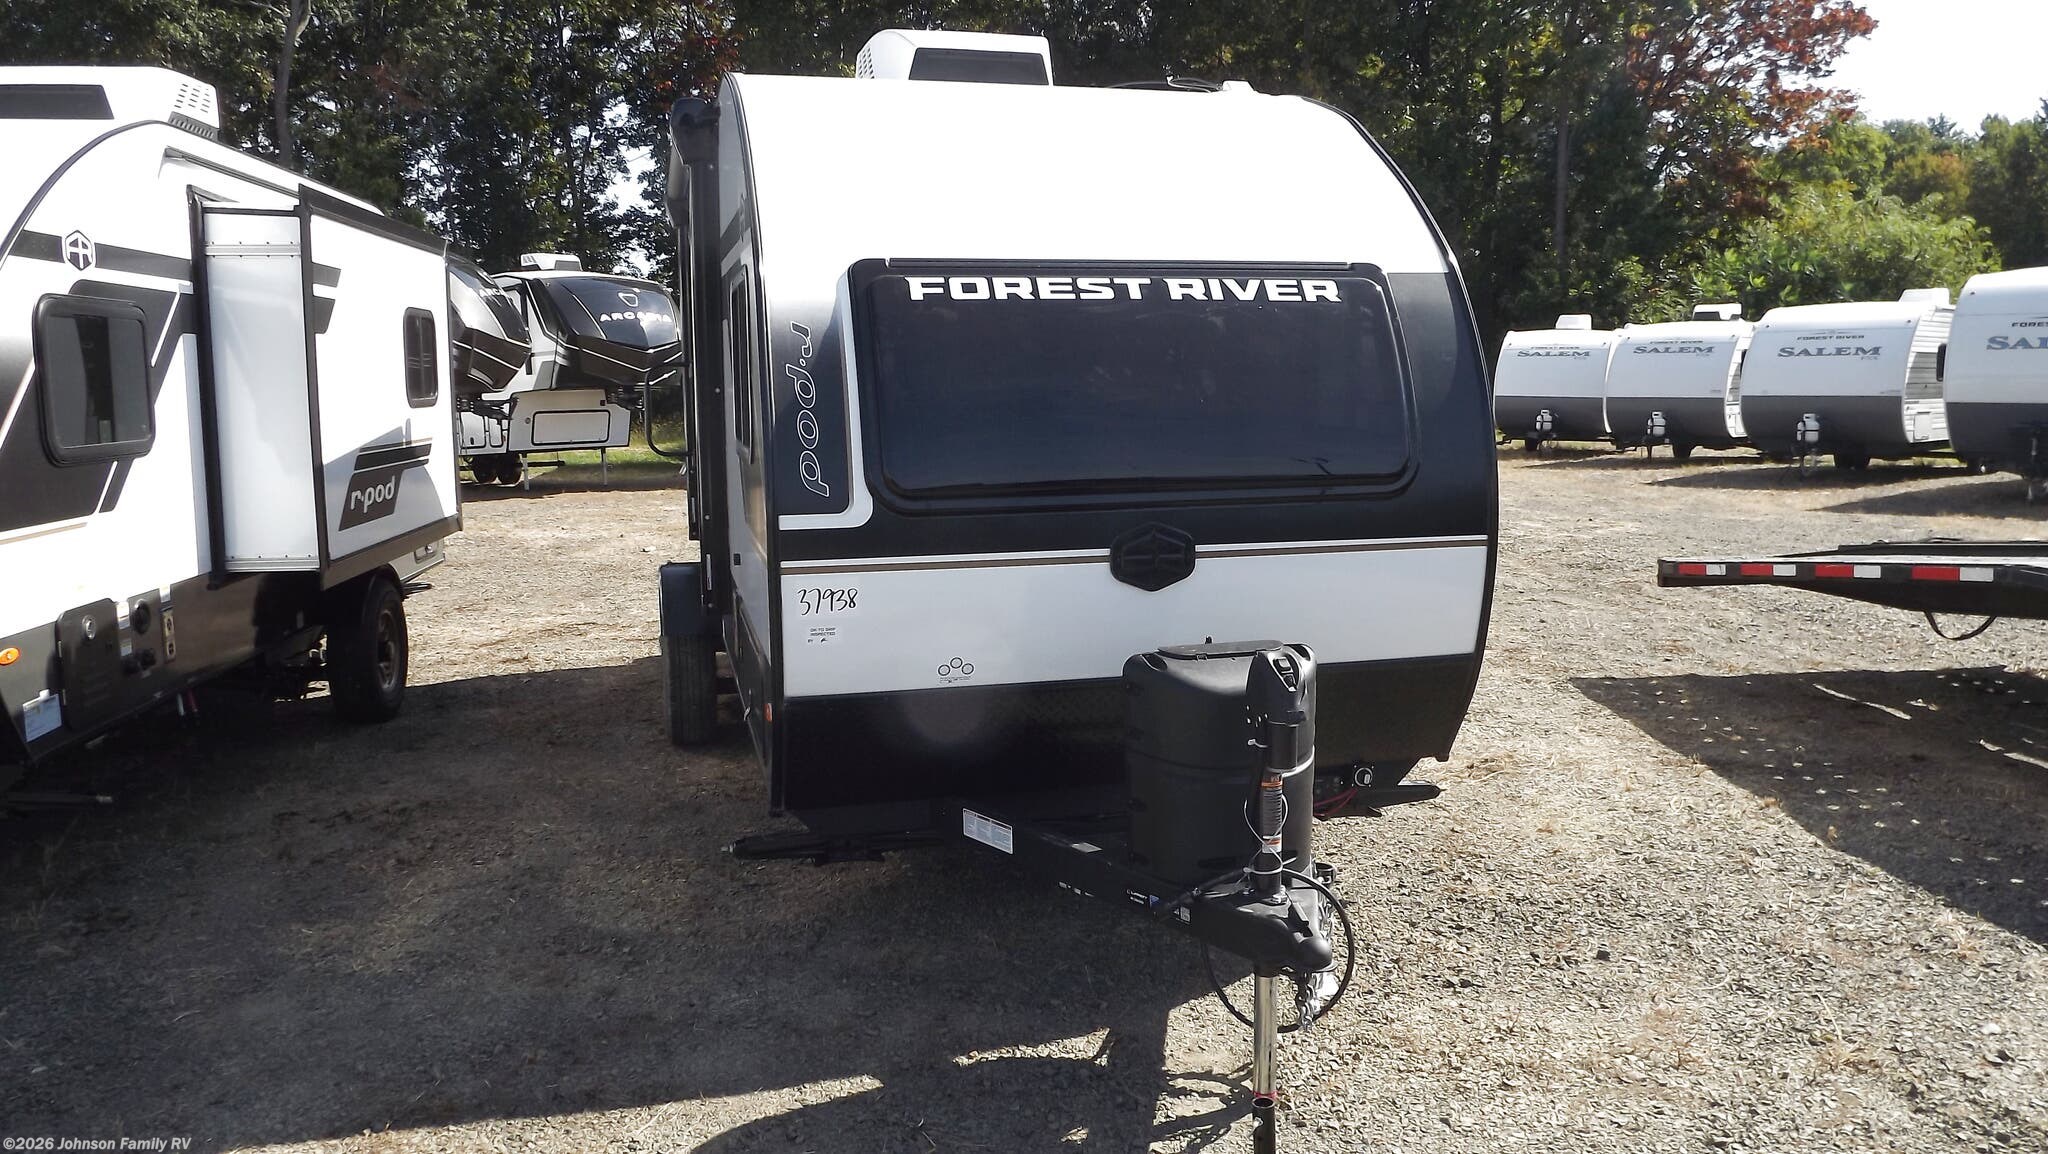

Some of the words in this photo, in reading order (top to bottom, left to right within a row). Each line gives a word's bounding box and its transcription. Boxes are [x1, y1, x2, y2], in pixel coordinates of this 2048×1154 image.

[904, 276, 1152, 301] FOREST
[1163, 278, 1342, 302] RIVER
[1633, 346, 1715, 354] SALEM
[1777, 346, 1882, 357] SALEM
[797, 587, 858, 616] 37938
